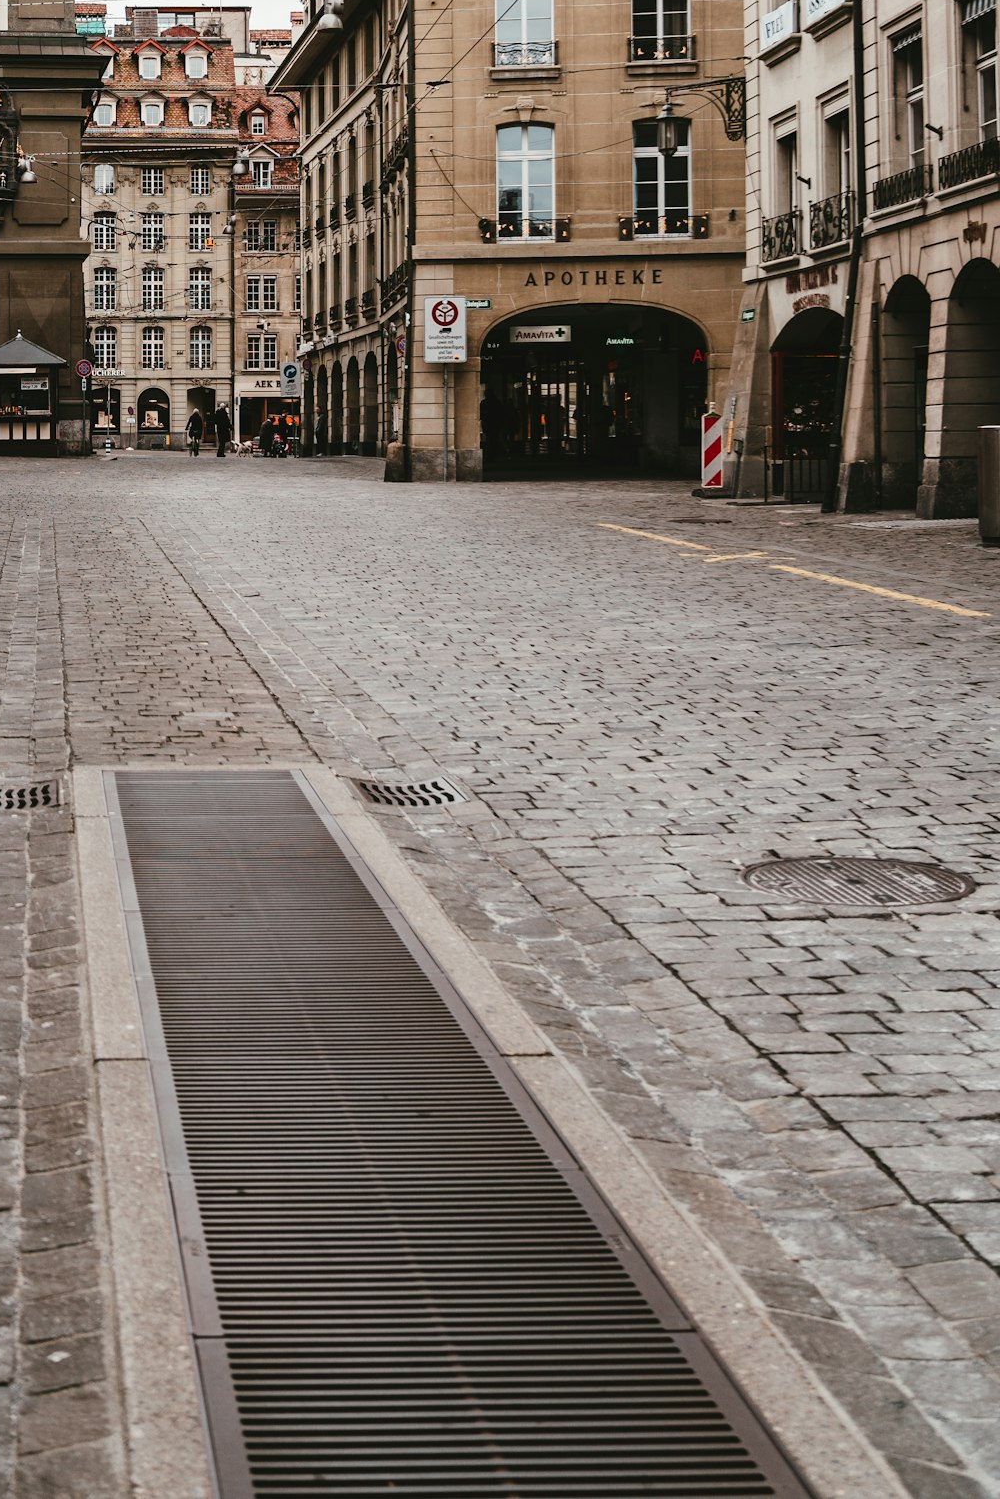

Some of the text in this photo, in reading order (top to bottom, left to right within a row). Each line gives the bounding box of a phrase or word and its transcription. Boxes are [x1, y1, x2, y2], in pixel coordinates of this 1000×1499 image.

[524, 270, 662, 286] APOTHEKE
[91, 369, 126, 377] UCHERER
[255, 380, 273, 388] AEK
